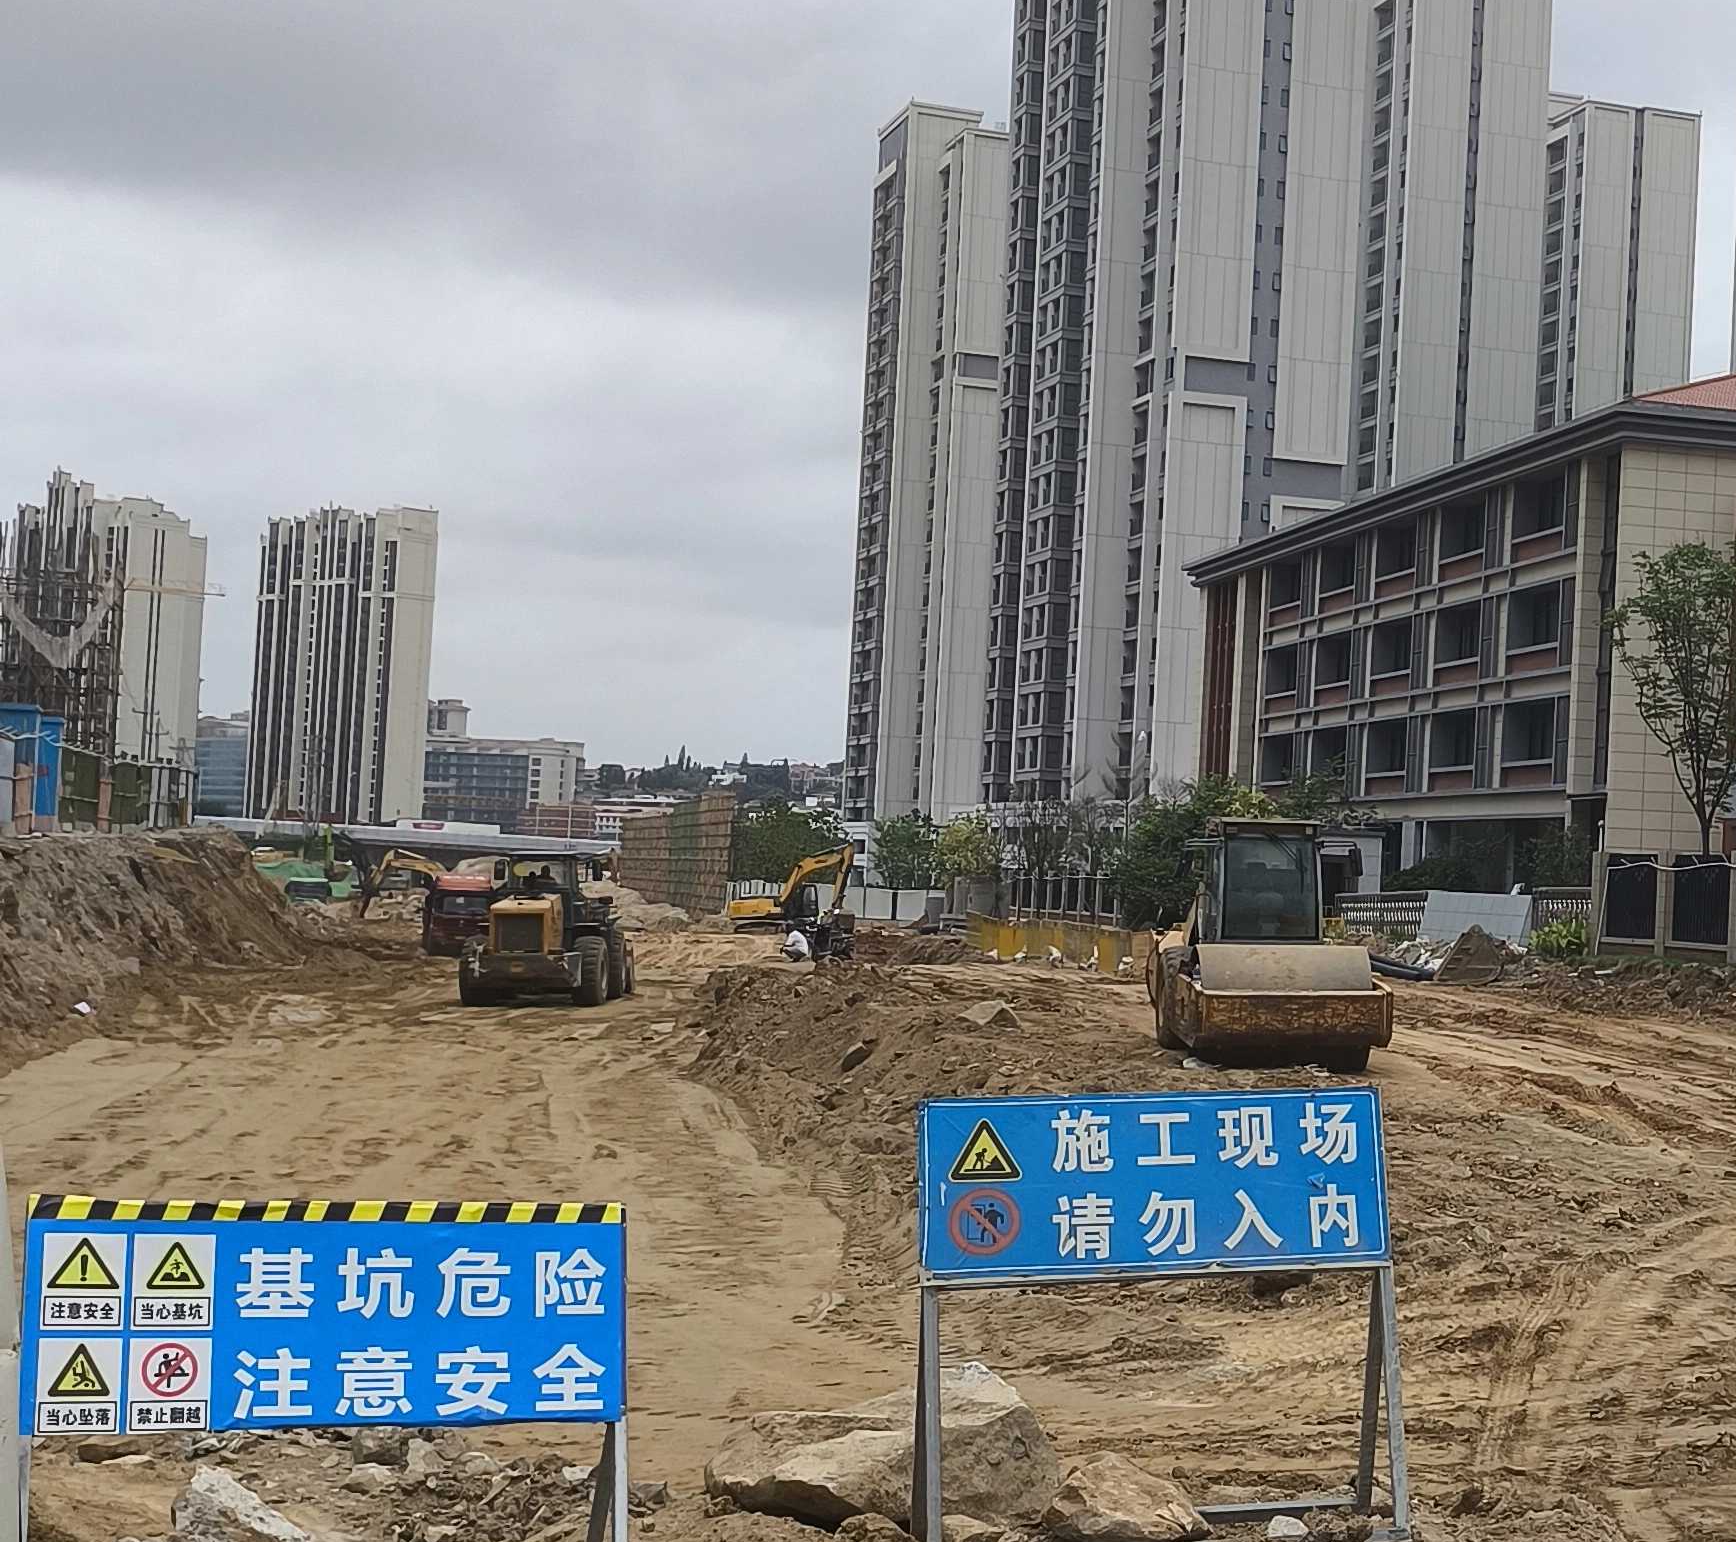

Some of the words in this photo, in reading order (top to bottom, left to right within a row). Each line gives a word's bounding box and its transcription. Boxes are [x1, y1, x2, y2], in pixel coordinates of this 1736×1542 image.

[1050, 1103, 1358, 1173] 施工现场
[1051, 1183, 1360, 1261] 请勿入内
[50, 1302, 115, 1320] 注意安全
[140, 1303, 204, 1320] 当心基坑
[235, 1247, 607, 1319] 基坑危险
[46, 1408, 111, 1426] 当心坠落
[232, 1344, 608, 1420] 注意安全
